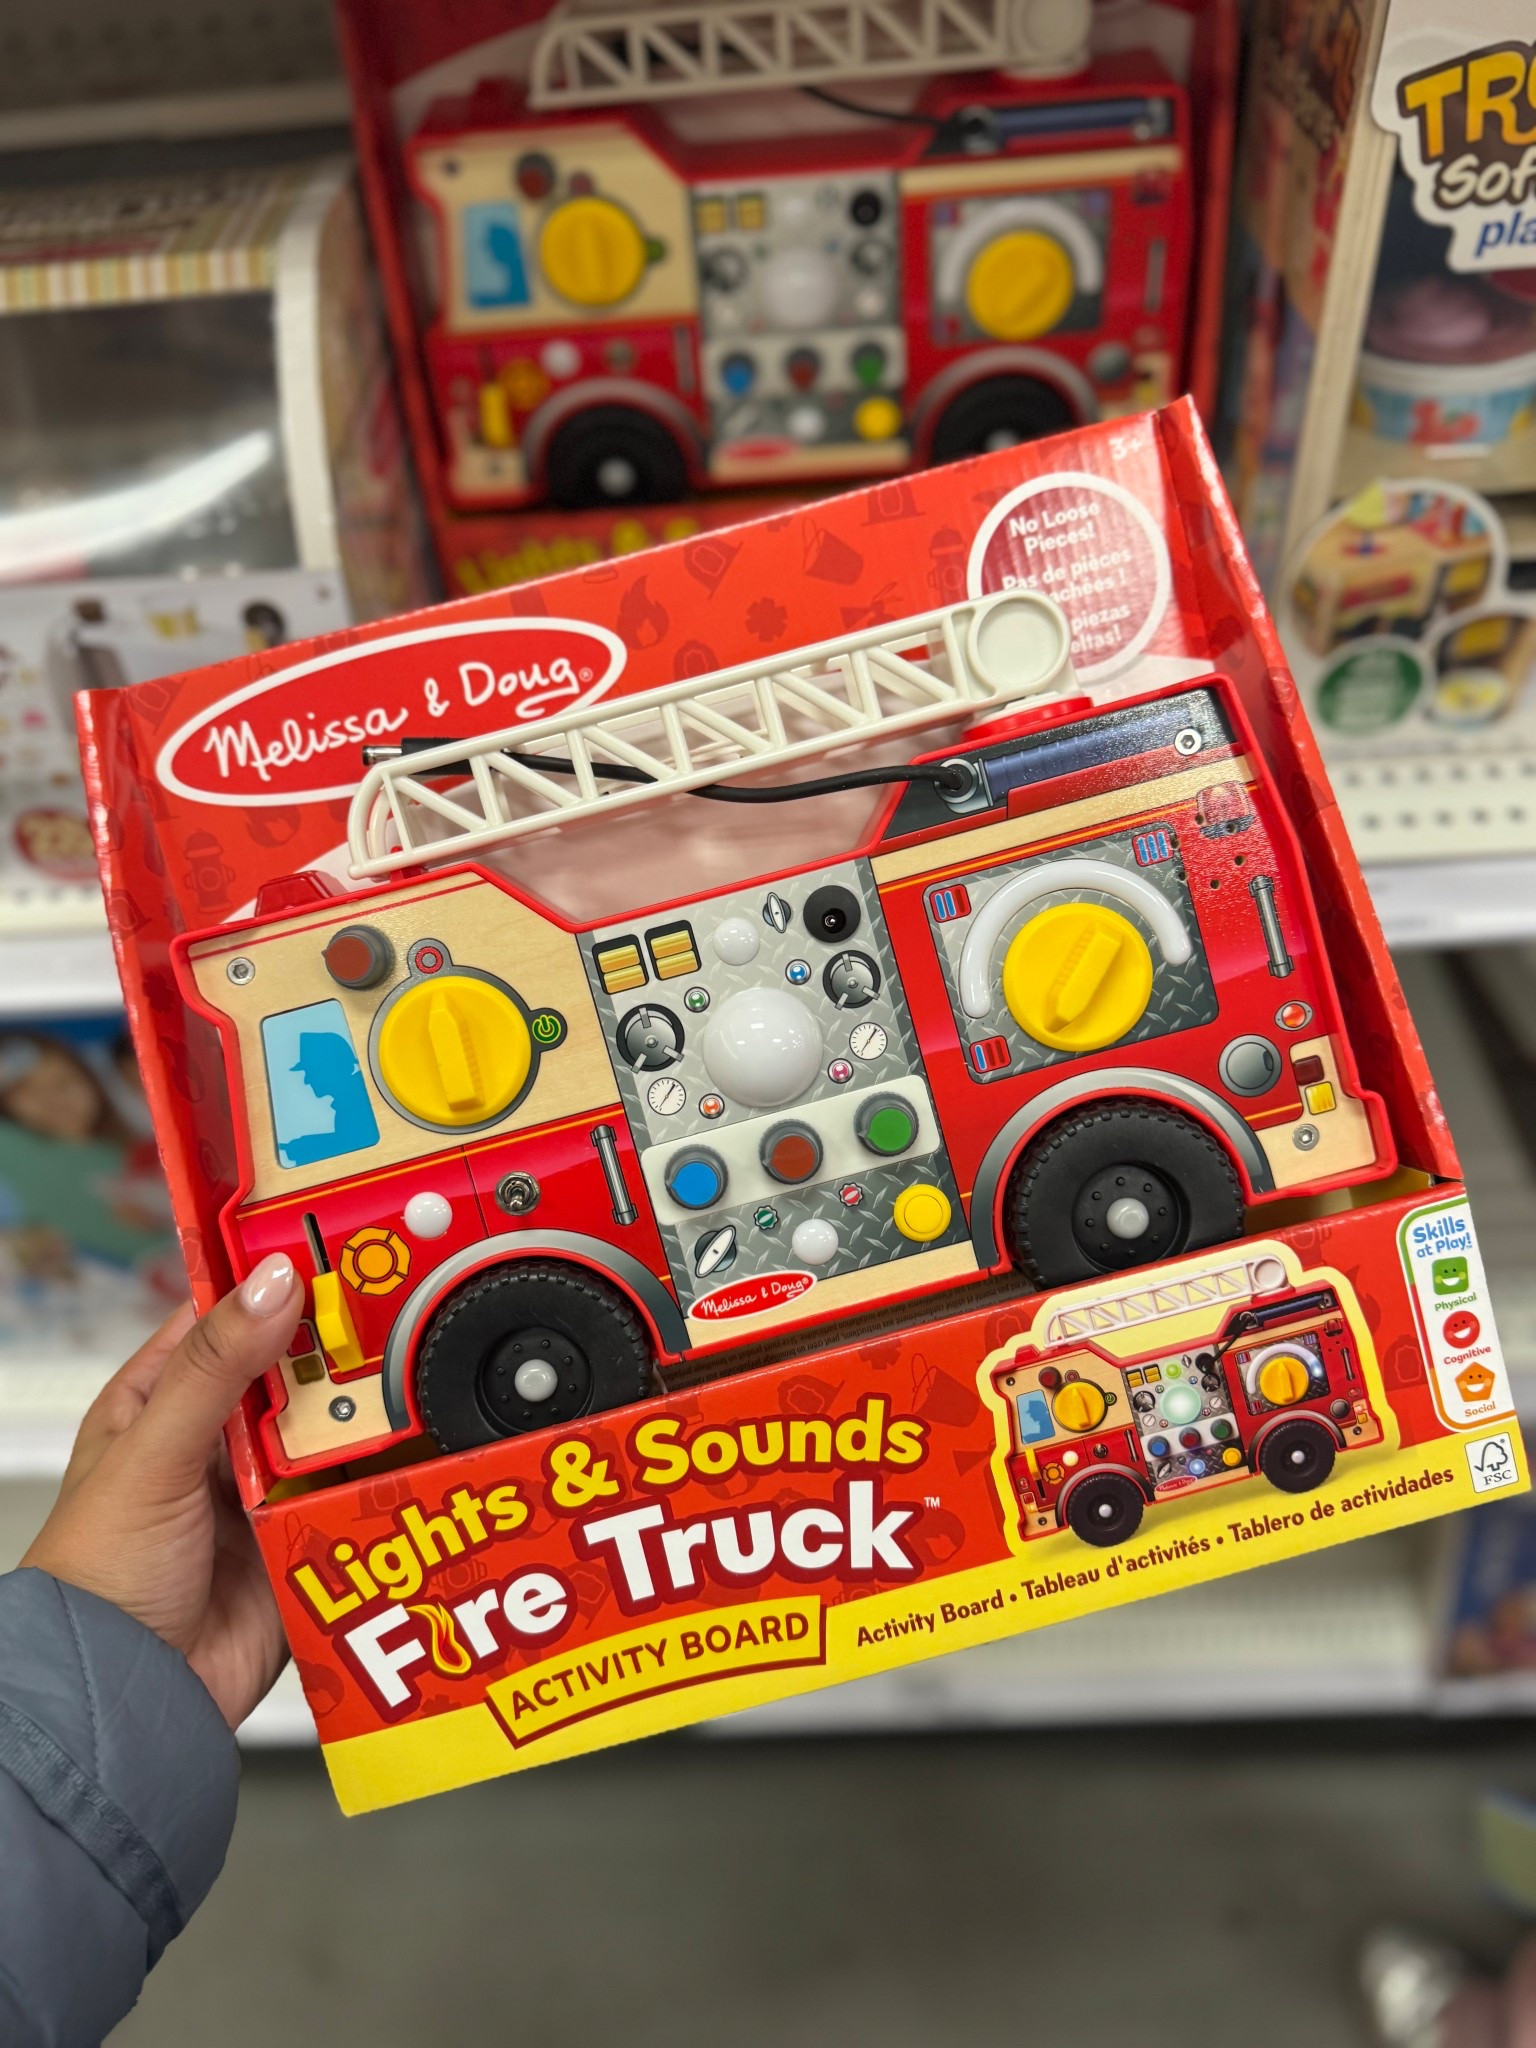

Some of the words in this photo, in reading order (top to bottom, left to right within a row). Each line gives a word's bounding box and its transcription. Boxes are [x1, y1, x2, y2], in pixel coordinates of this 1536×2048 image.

[1405, 49, 1536, 157] TR
[1109, 437, 1142, 460] 3+
[1009, 516, 1038, 538] No
[1042, 502, 1100, 529] Loose
[1024, 522, 1095, 556] Pieces!
[1002, 574, 1038, 591] Pas
[1043, 562, 1066, 584] de
[1071, 549, 1132, 580] pièces
[1071, 603, 1131, 636] piezas
[1070, 624, 1122, 654] eltas!
[204, 708, 408, 781] Melissa
[423, 678, 449, 718] &
[1412, 1216, 1466, 1244] Skills
[1416, 1245, 1432, 1258] at
[702, 1294, 756, 1316] Melissa
[761, 1287, 768, 1298] &
[1435, 1293, 1477, 1312] Physical
[1443, 1345, 1491, 1366] Cognitive
[1464, 1401, 1497, 1417] Social
[1483, 1469, 1513, 1486] FSC
[293, 1481, 529, 1626] Lights
[548, 1438, 620, 1509] &
[635, 1398, 924, 1487] Sounds
[857, 1612, 936, 1647] Activity
[939, 1589, 1004, 1624] Board
[1021, 1568, 1100, 1600] Tableau
[1106, 1535, 1211, 1578] d'activités
[1227, 1514, 1305, 1543] Tablero
[1309, 1500, 1335, 1521] de
[1341, 1468, 1455, 1512] actividades
[510, 1638, 668, 1721] ACTIVITY
[681, 1611, 811, 1662] BOARD
